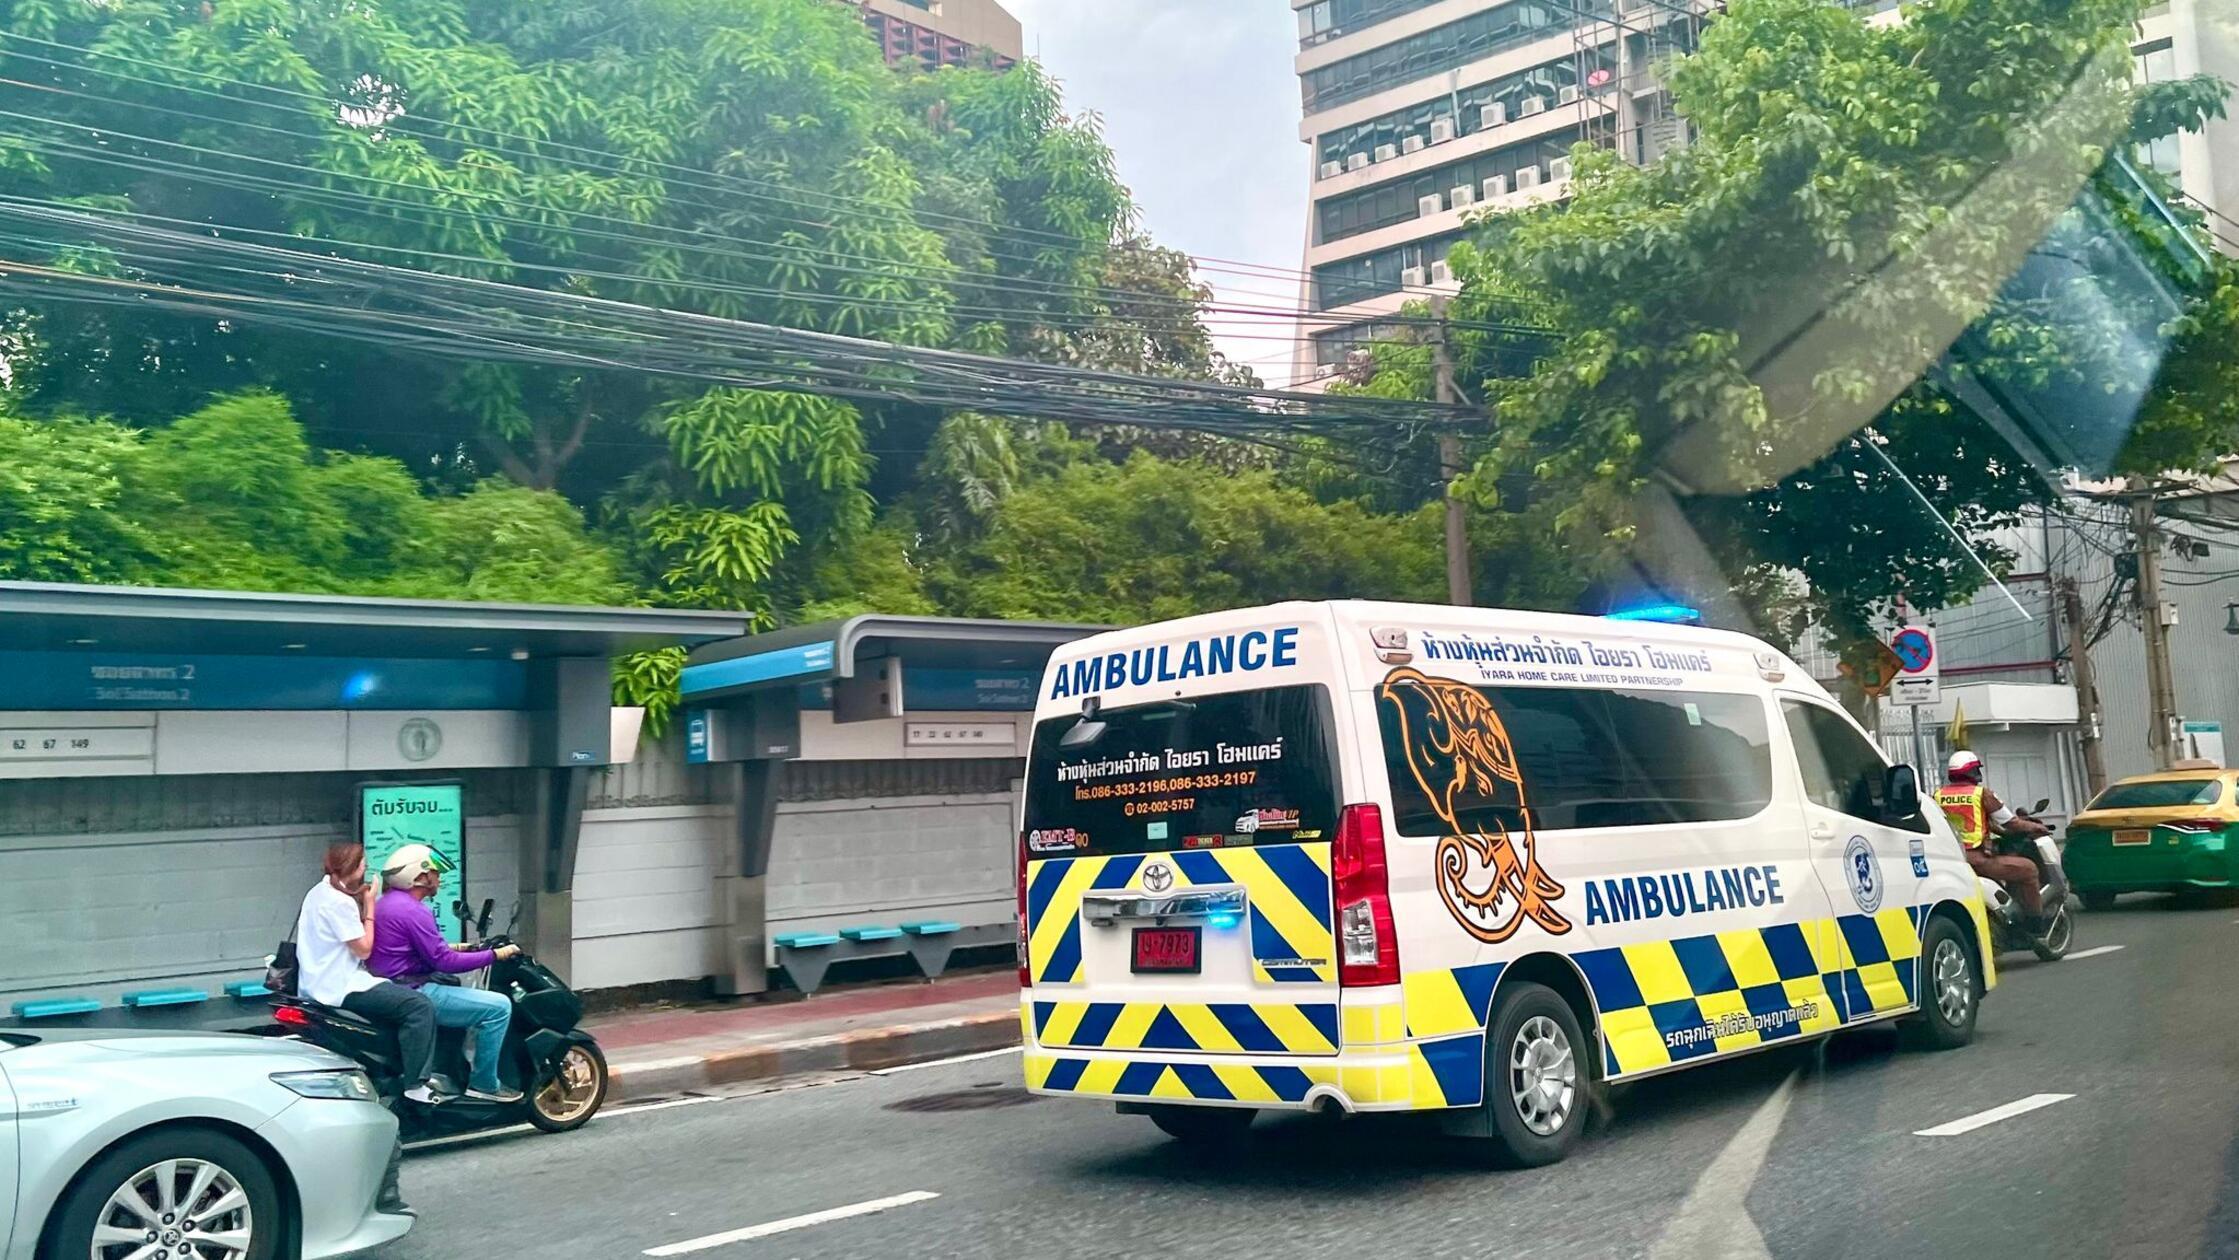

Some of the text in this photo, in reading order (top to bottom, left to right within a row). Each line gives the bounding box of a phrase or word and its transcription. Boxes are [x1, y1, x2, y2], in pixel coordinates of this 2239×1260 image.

[1051, 627, 1299, 700] AMBULANCE
[1420, 631, 1712, 672] ห้างหุ้นส่วนจำกัด ไอยรา โฮมแคร์
[182, 664, 195, 679] 2
[1481, 669, 1684, 687] IYARA HOME CARE LIMITED PARTNERSHIP
[13, 739, 26, 749] 62
[1057, 737, 1284, 784] ห้างหุ้นส่วนจำกัด ไอยรา โฮมแคร์
[1075, 771, 1257, 800] โทร.086-333-2196,086-333-2197
[1940, 795, 1973, 805] POLICE
[1136, 798, 1195, 814] 02-002-5757
[1585, 865, 1785, 926] AMBULANCE
[1666, 998, 1819, 1050] รถฉุกเฉินได้รับอนุญาตแล้ว
